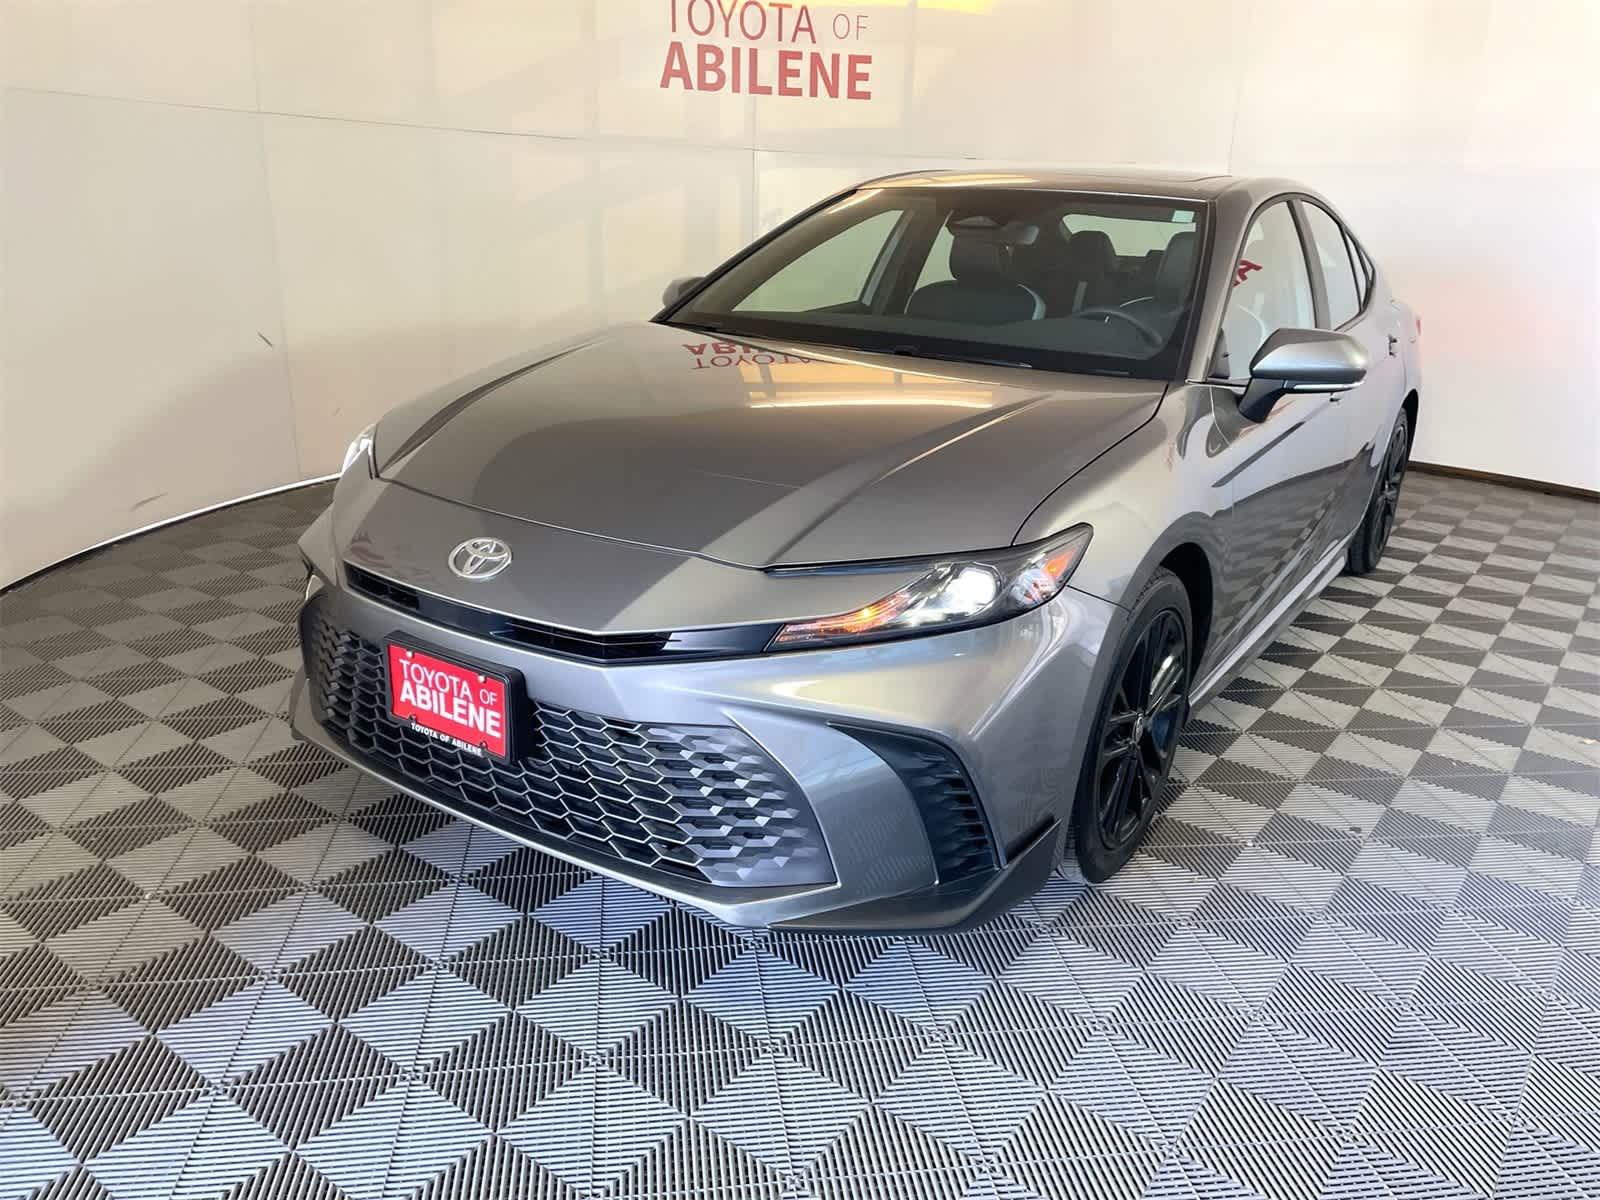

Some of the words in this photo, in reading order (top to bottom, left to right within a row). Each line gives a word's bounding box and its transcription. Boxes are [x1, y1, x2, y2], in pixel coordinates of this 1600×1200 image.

[670, 0, 817, 44] TOYOTA
[832, 13, 869, 41] OF
[659, 41, 872, 100] ABILENE
[399, 659, 473, 702] TOYOTA
[479, 689, 497, 706] OF
[400, 680, 501, 738] ABILENE
[411, 722, 438, 738] TOYOTA
[440, 734, 450, 743] OF
[452, 739, 482, 757] ABILENE
